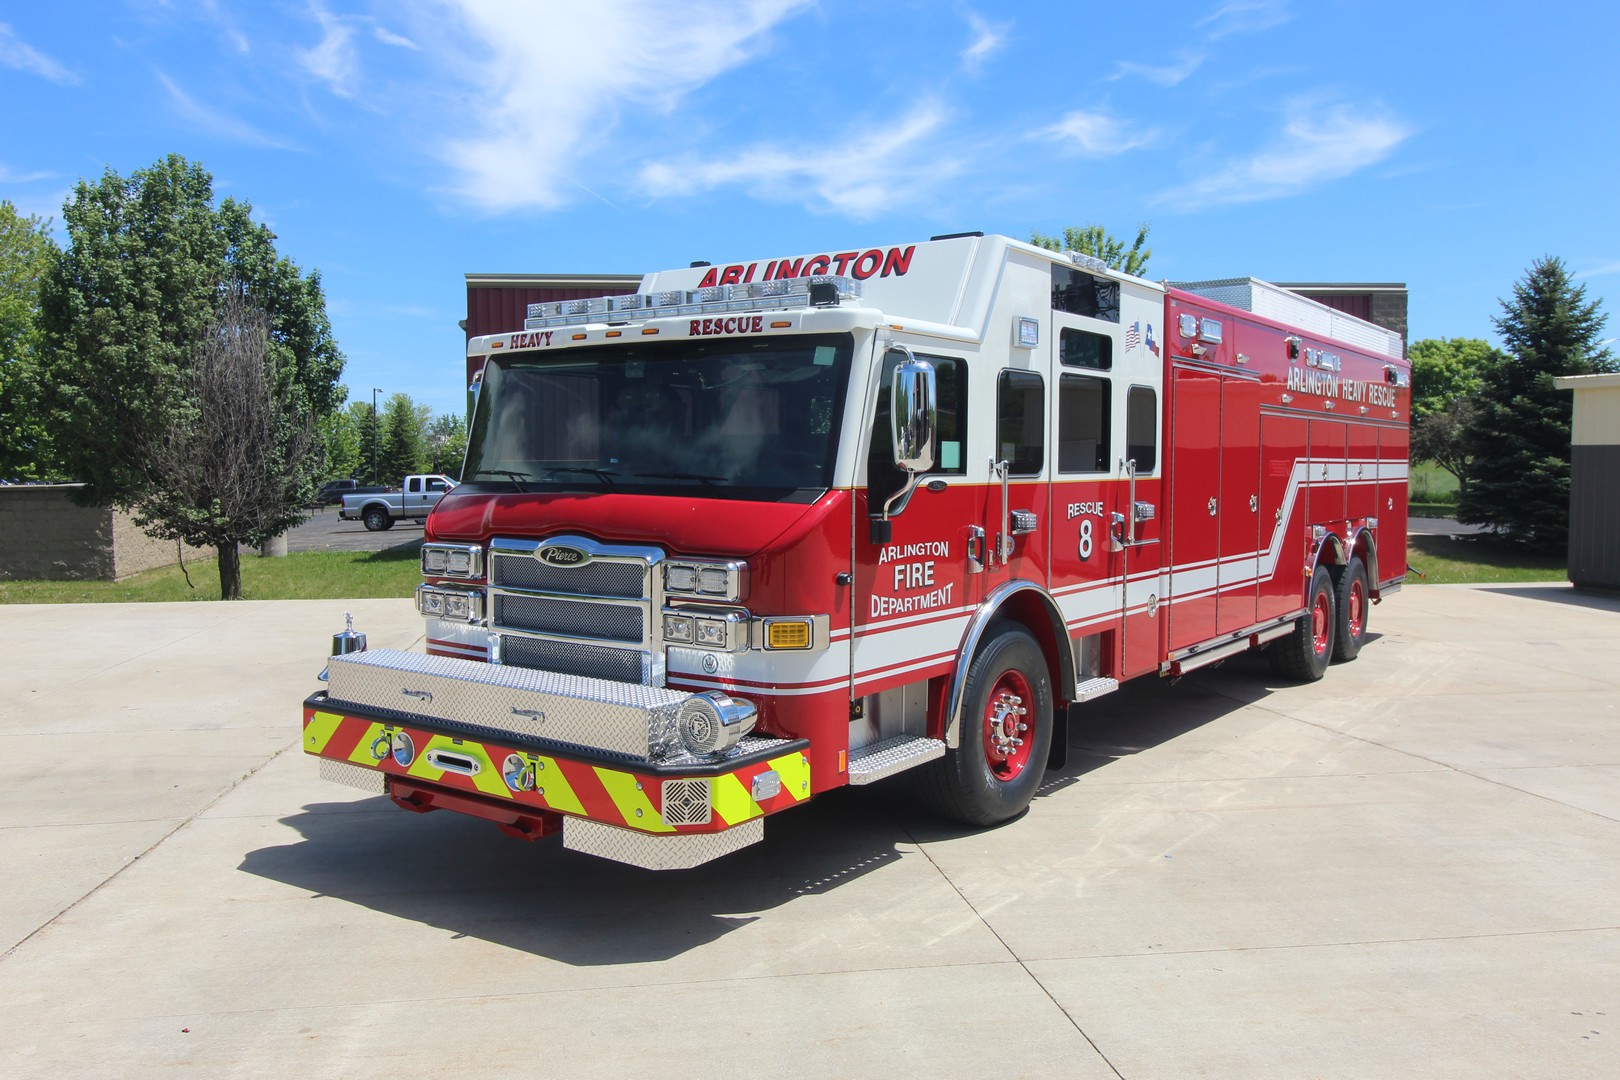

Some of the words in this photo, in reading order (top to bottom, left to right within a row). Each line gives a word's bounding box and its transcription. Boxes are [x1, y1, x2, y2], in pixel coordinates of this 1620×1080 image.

[510, 331, 554, 349] HEAVY
[689, 316, 763, 336] RESCUE
[1287, 366, 1338, 398] ARLINGTON
[1342, 378, 1366, 402] HEAVY
[1369, 384, 1395, 407] RESCUE
[1067, 502, 1104, 521] RESCUE
[546, 547, 577, 562] Pierce
[878, 541, 949, 565] ARLINGTON
[1078, 519, 1093, 562] 8
[894, 561, 935, 591] FIRE
[871, 582, 954, 618] DEPARTMENT
